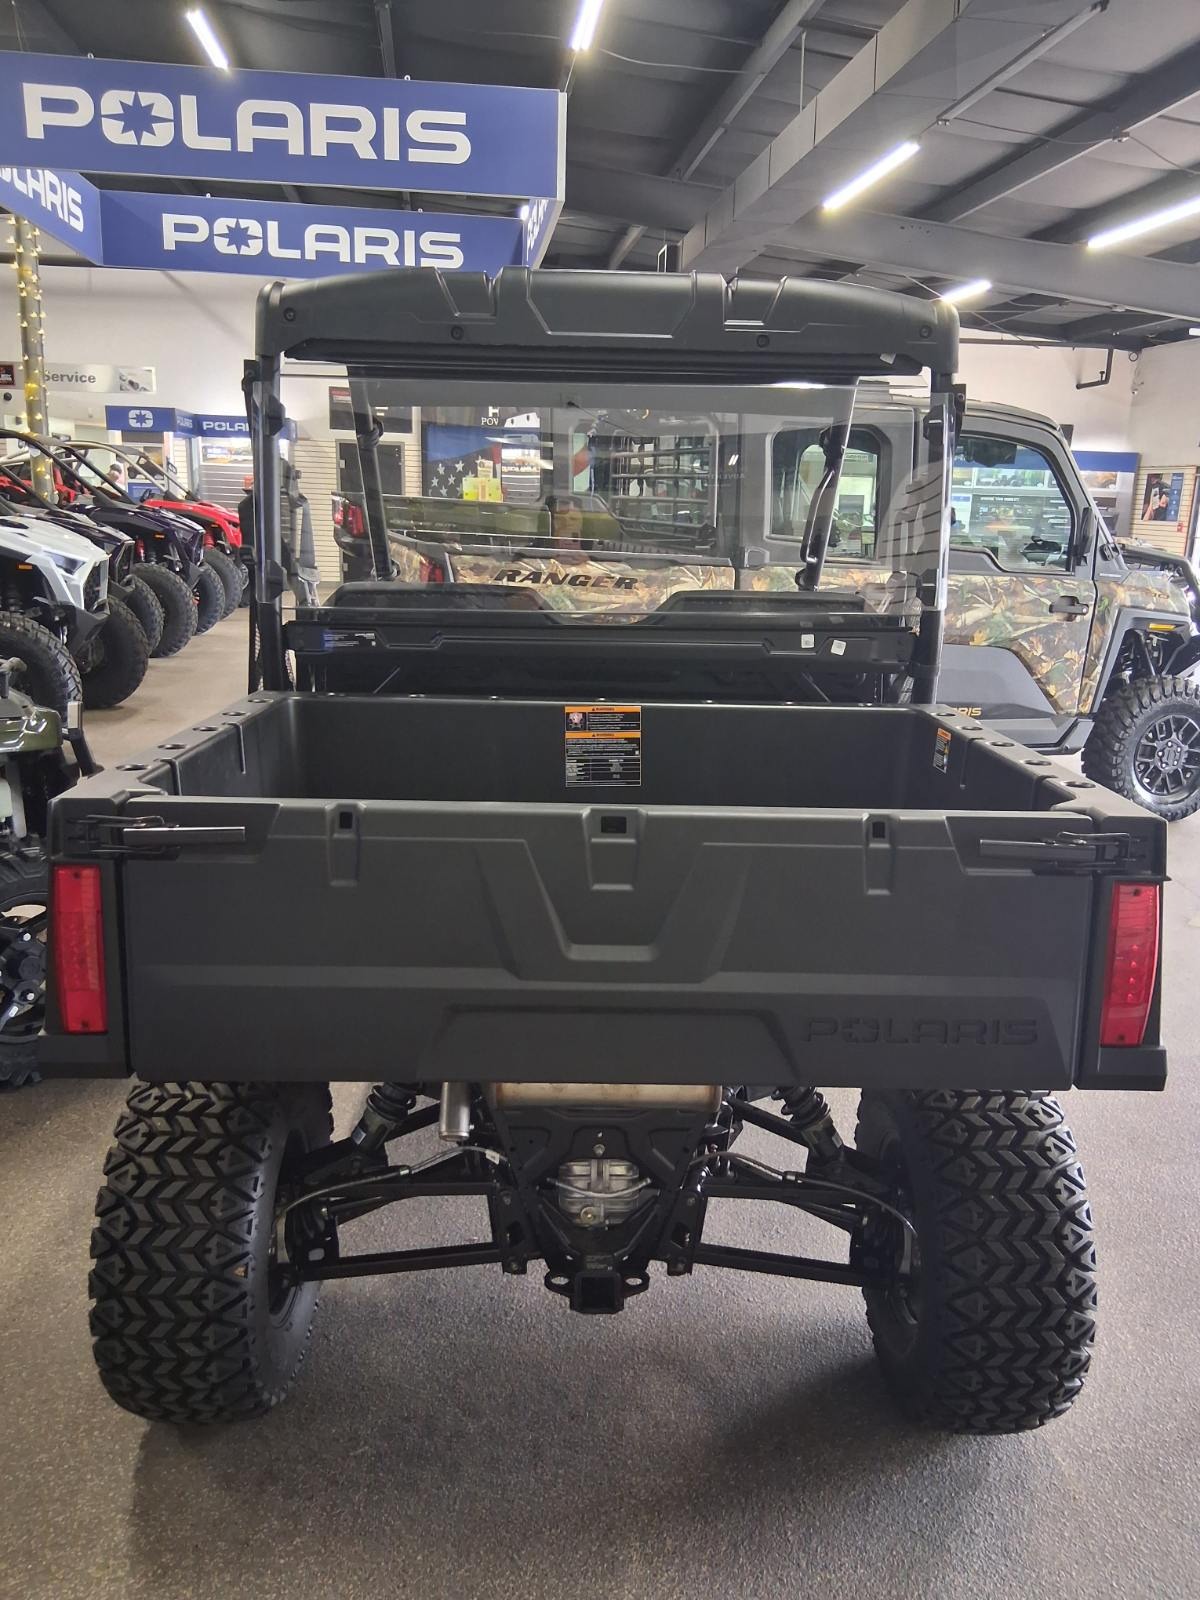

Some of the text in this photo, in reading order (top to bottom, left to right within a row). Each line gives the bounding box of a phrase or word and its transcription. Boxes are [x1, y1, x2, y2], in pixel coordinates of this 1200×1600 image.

[22, 82, 472, 165] POLARIS
[0, 168, 84, 232] LARIS
[162, 213, 465, 269] POLARIS
[44, 371, 96, 384] Service
[494, 569, 638, 590] RANGER
[803, 1017, 1039, 1046] POLARIS
